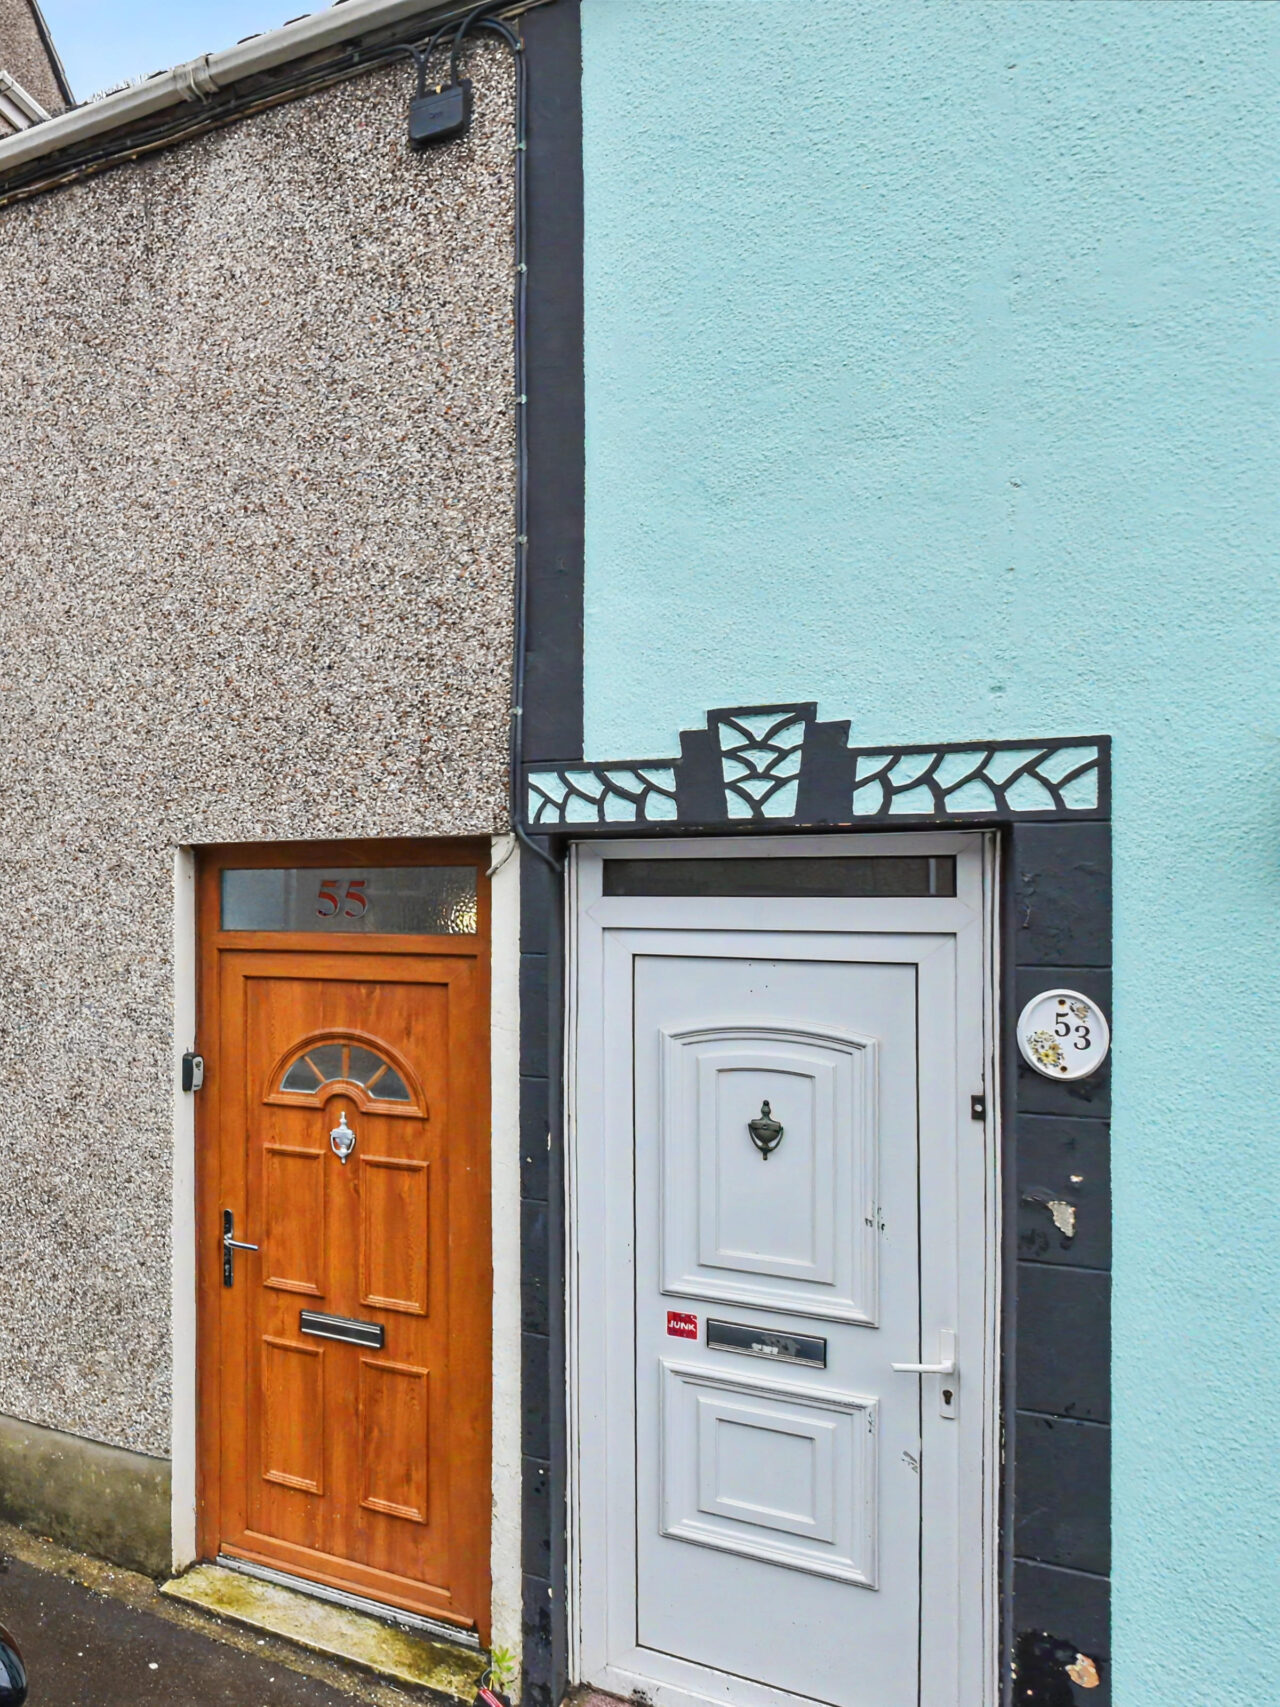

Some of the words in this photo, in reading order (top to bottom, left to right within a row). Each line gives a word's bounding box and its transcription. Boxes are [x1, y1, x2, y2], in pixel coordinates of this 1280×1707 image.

[317, 880, 368, 919] 55
[1054, 1012, 1091, 1051] 53
[668, 1320, 696, 1332] JUNK
